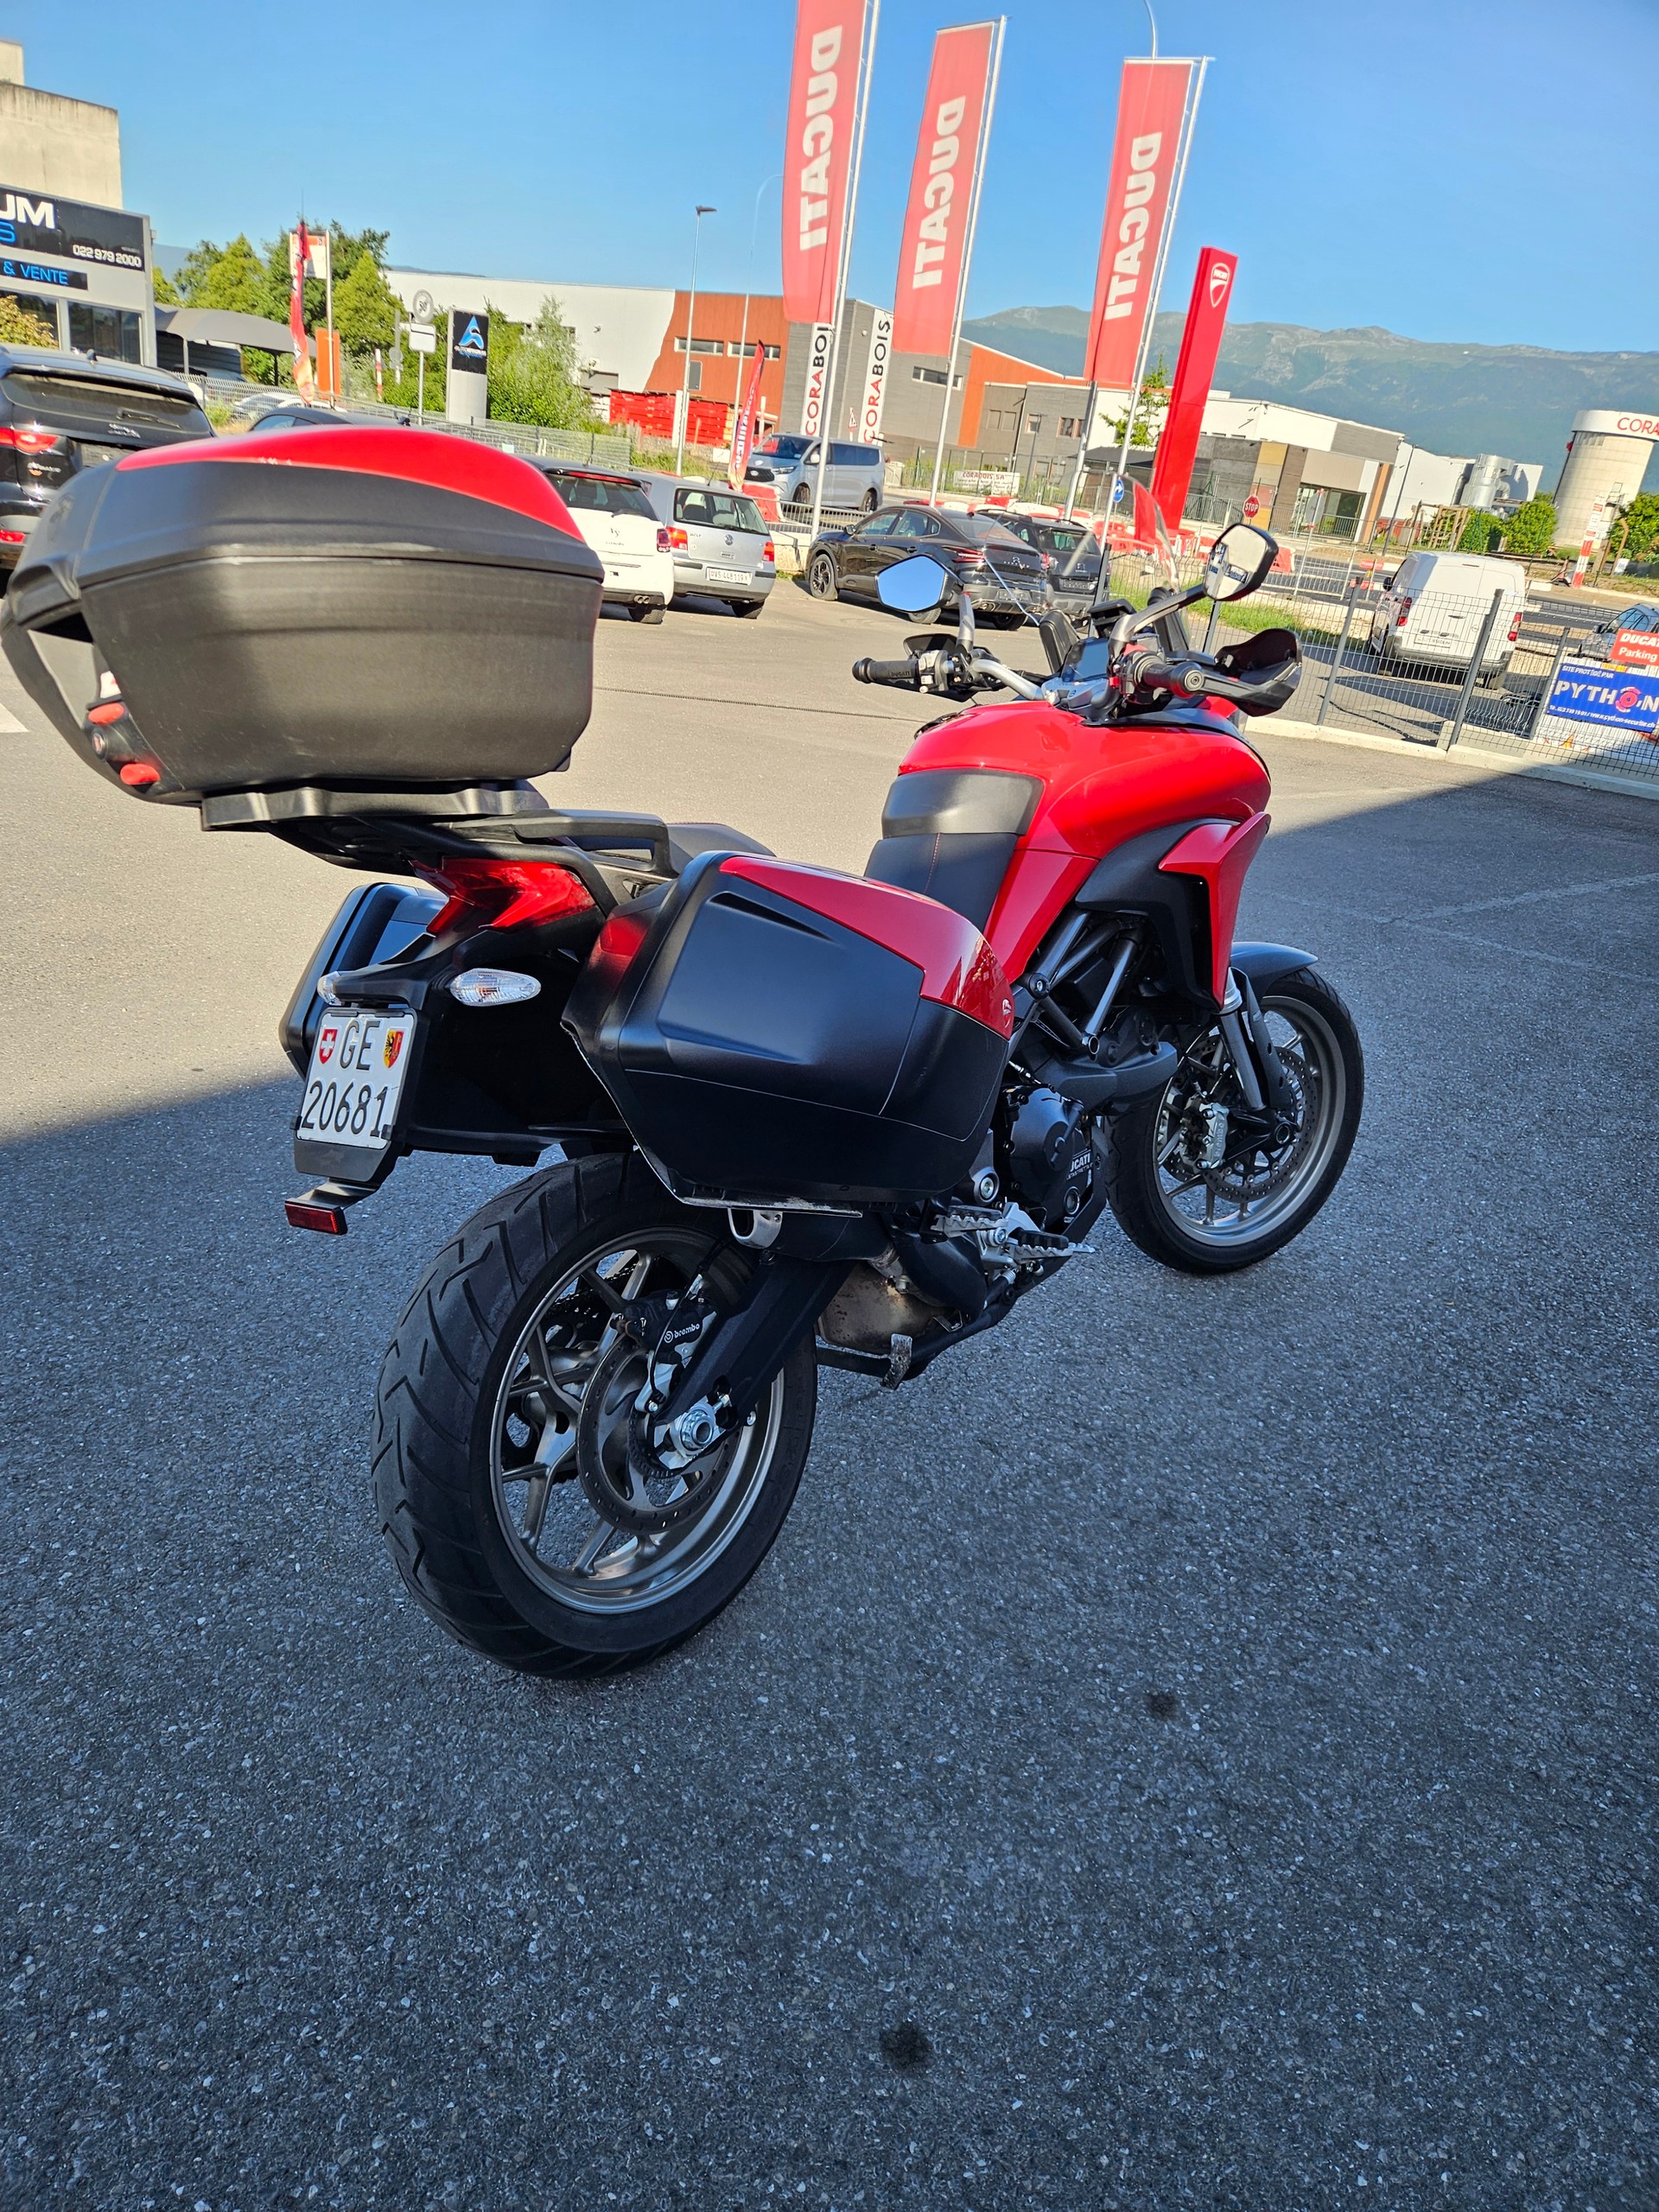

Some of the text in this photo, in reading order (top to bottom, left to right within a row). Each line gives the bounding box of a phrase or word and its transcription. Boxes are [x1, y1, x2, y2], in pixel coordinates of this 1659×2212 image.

[72, 245, 94, 259] 022
[94, 248, 115, 263] 979
[115, 252, 143, 268] 2000
[3, 261, 69, 286] & VENTE
[805, 327, 830, 435] CORABOI
[864, 320, 891, 443] CORABOIS
[1245, 502, 1259, 512] STOP
[1619, 632, 1659, 648] DUCA
[1618, 646, 1658, 663] Parking
[340, 1020, 381, 1071] GE
[301, 1080, 388, 1138] 20681
[674, 1323, 701, 1338] brembo
